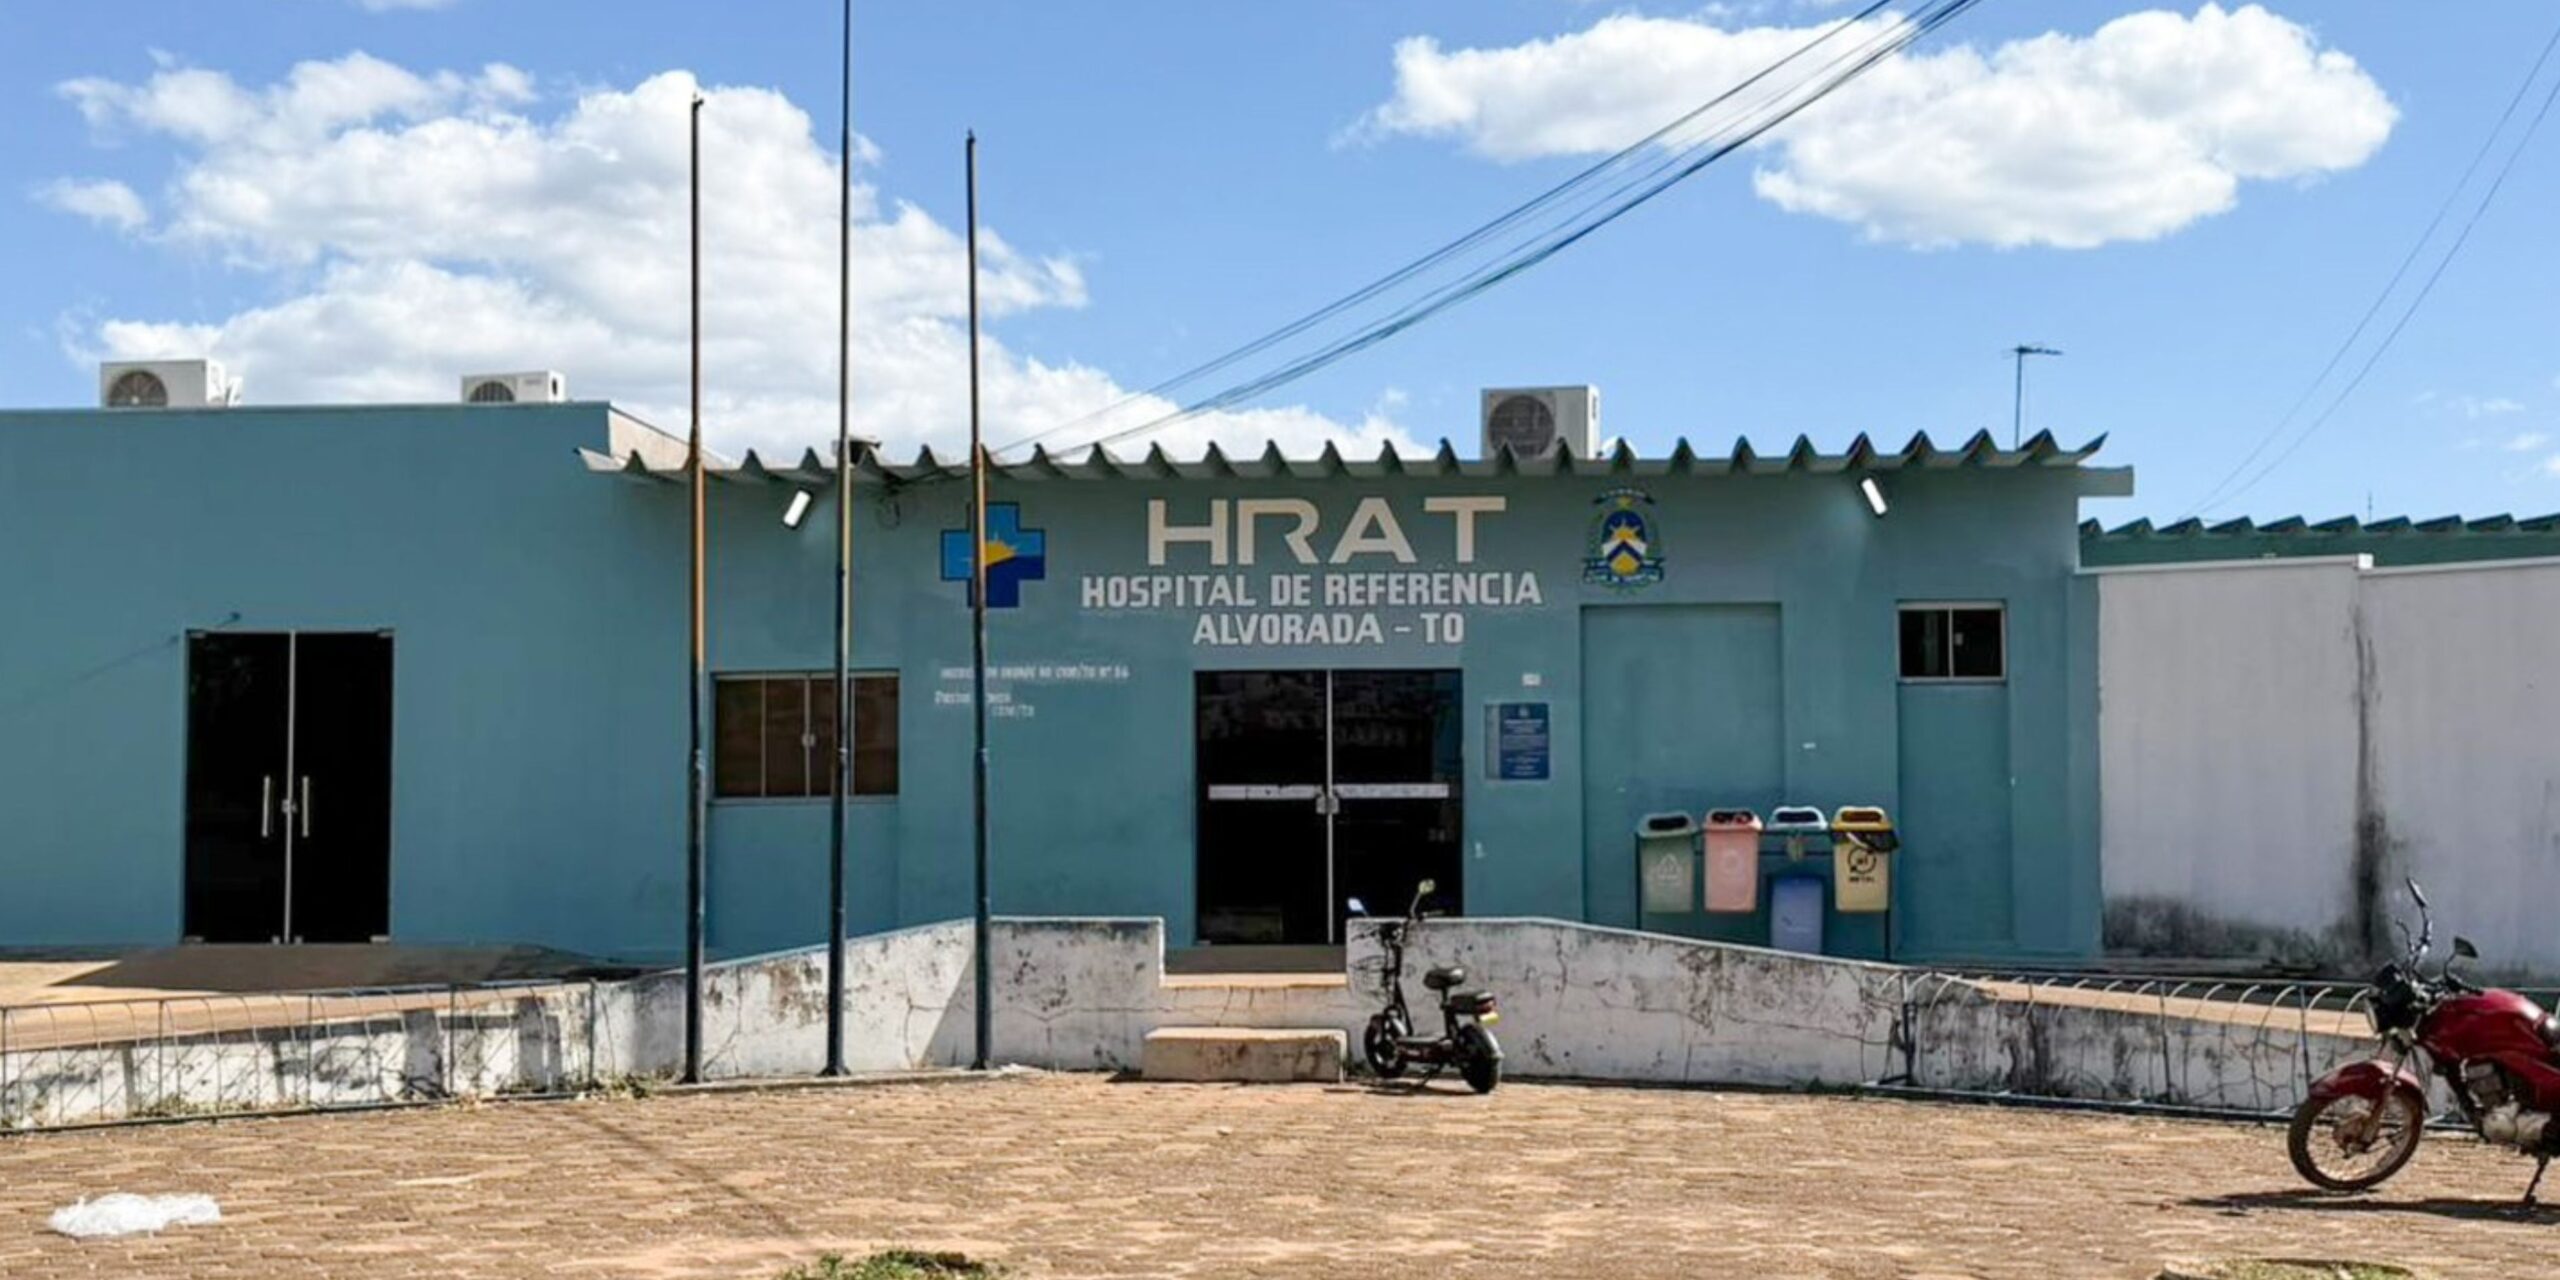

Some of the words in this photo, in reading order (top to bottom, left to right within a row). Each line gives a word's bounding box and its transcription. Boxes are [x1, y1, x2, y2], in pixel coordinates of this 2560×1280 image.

[1148, 497, 1506, 566] HRAT
[1081, 575, 1257, 608] HOSPITAL
[1270, 574, 1312, 607] DE
[1324, 563, 1543, 606] REFERÊNCIA
[1192, 613, 1385, 645] ALVORADA
[1420, 612, 1465, 644] TO
